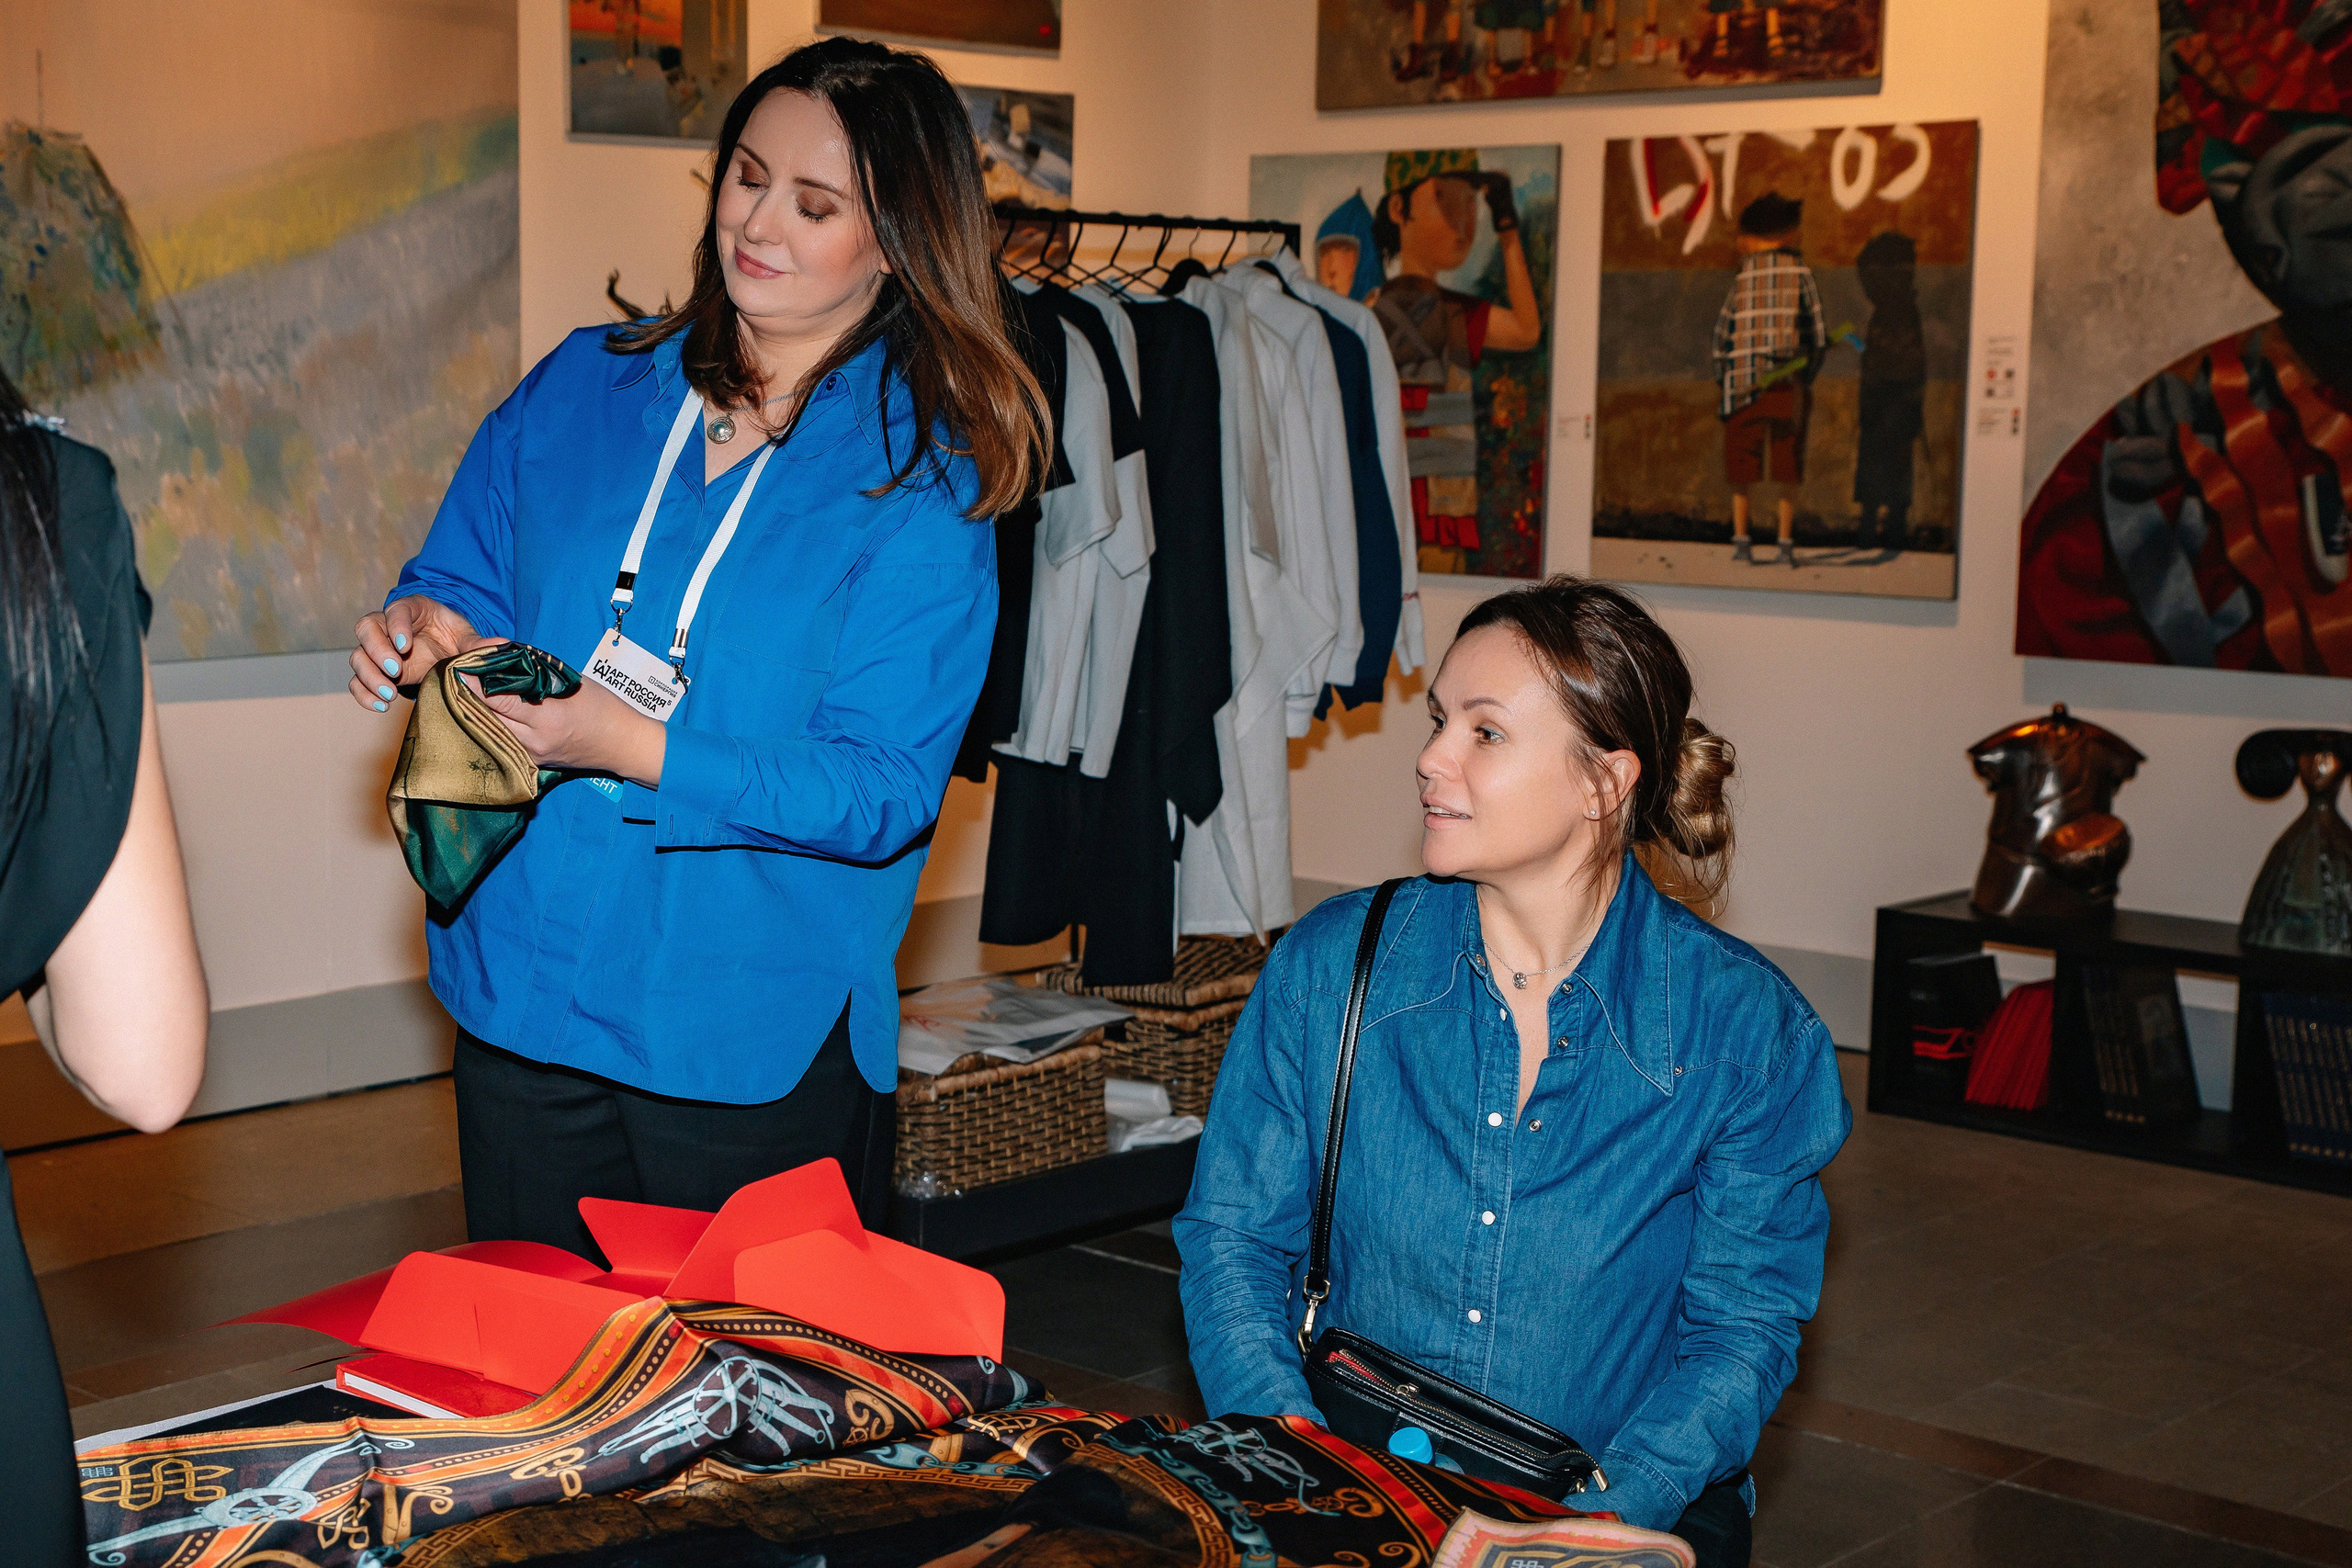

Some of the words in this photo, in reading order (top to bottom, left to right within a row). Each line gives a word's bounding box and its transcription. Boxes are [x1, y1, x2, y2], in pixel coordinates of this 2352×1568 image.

[605, 675, 626, 691] ART
[623, 686, 658, 714] RUSSIA
[609, 668, 630, 683] АРТ
[628, 679, 667, 708] РОССИЯ
